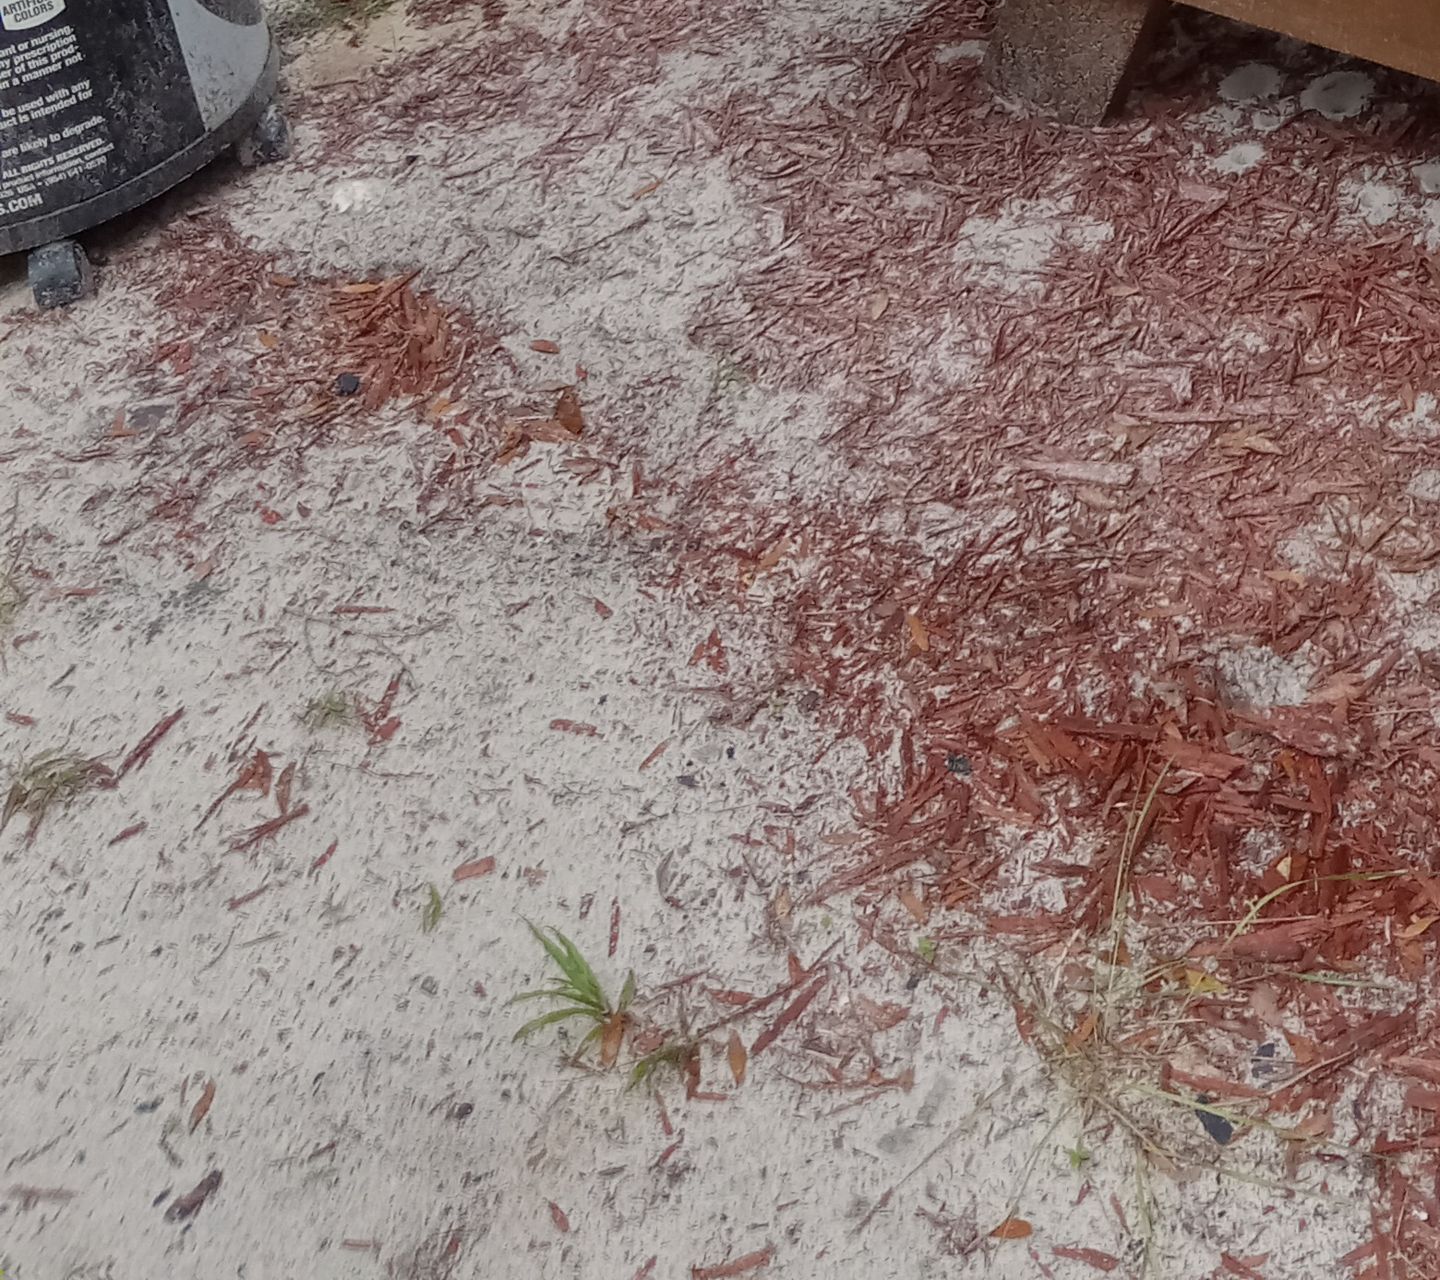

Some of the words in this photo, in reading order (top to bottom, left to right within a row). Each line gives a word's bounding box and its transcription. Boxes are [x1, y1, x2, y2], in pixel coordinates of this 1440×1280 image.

[13, 0, 55, 23] COLORS
[13, 34, 77, 66] prescription
[18, 41, 29, 51] or
[22, 61, 63, 83] manner
[27, 56, 49, 70] this
[1, 107, 17, 118] be
[17, 96, 45, 113] used
[45, 88, 70, 103] with
[70, 79, 91, 93] any
[1, 147, 19, 158] are
[2, 168, 21, 180] ALL
